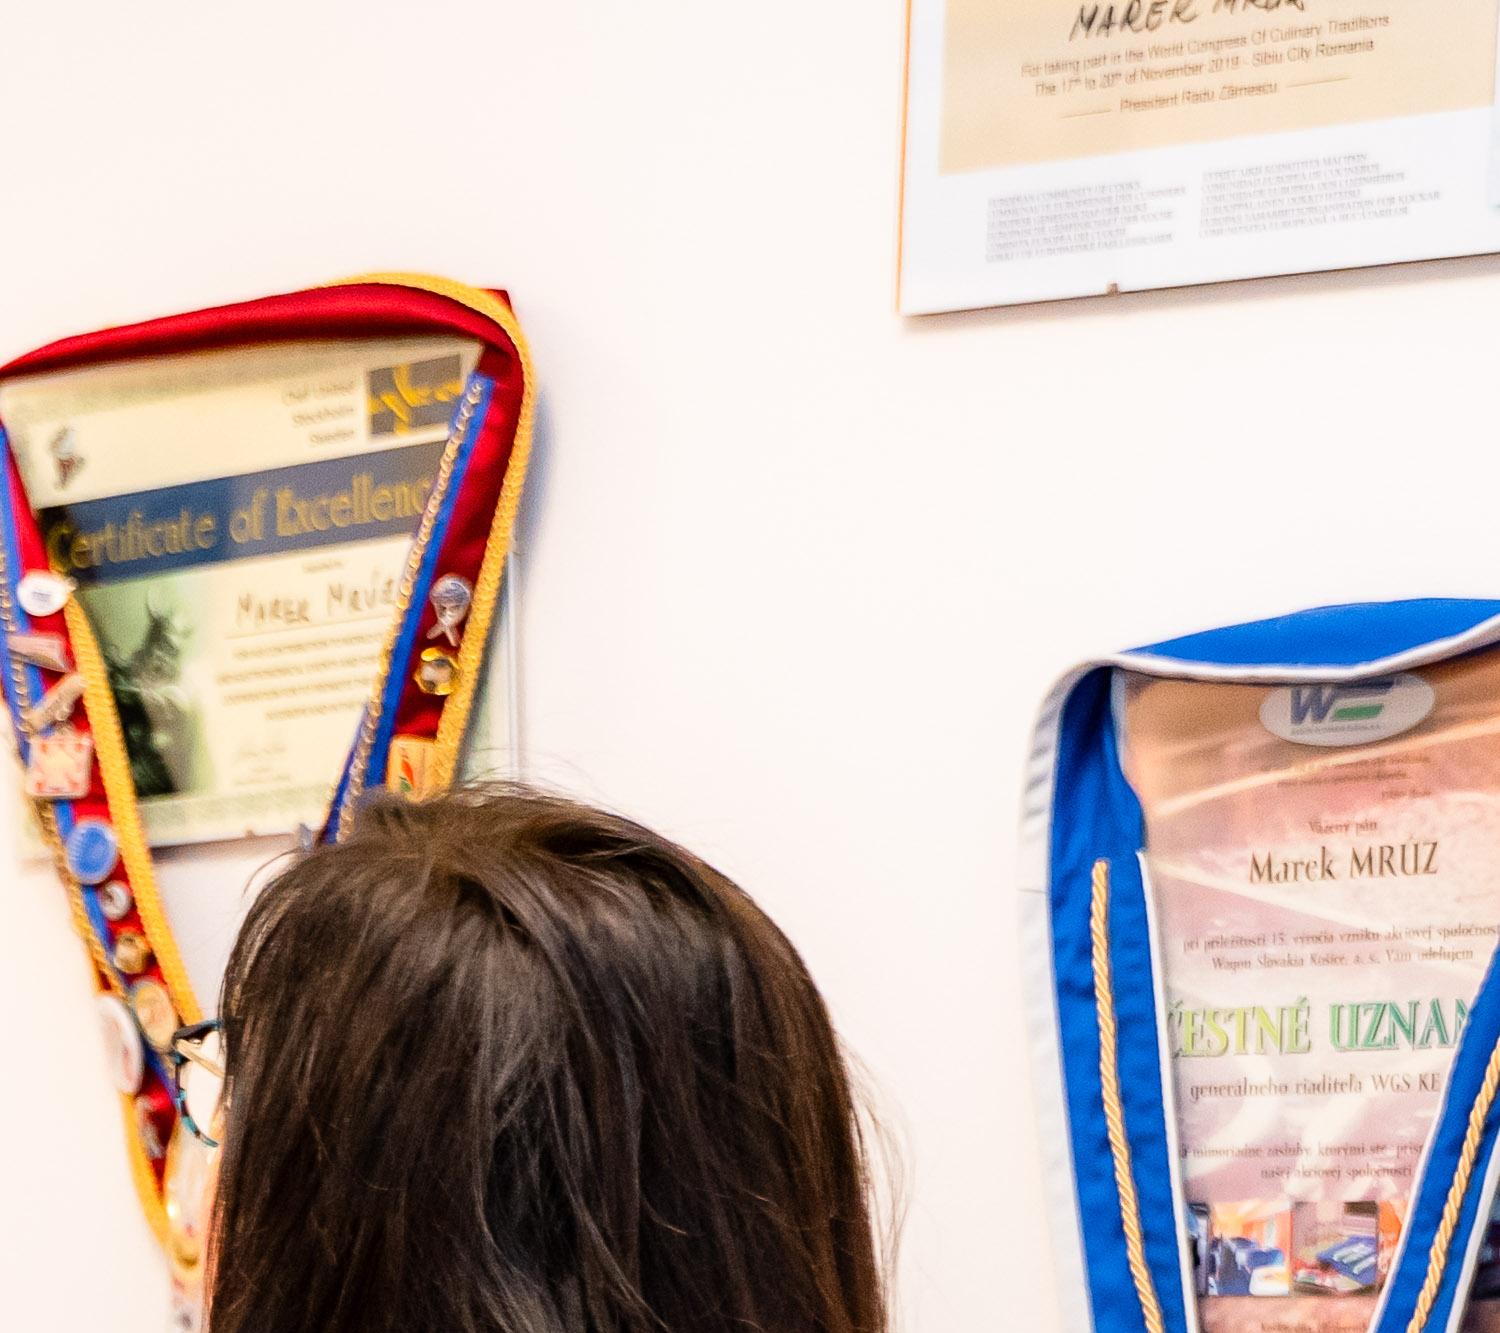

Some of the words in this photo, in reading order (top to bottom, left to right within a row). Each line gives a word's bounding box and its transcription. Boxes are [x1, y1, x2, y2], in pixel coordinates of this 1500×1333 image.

[1125, 49, 1144, 65] the
[1148, 44, 1184, 62] World
[1188, 36, 1247, 57] Congress
[1271, 25, 1321, 48] Culinary
[1140, 61, 1205, 83] November
[1315, 38, 1375, 58] Romania
[1120, 90, 1178, 113] President
[229, 487, 268, 545] of
[276, 472, 434, 538] Excellenc
[1249, 845, 1337, 885] Marek
[1189, 1076, 1289, 1104] generálneho
[1372, 1074, 1413, 1093] WGS
[1418, 1073, 1441, 1093] KE
